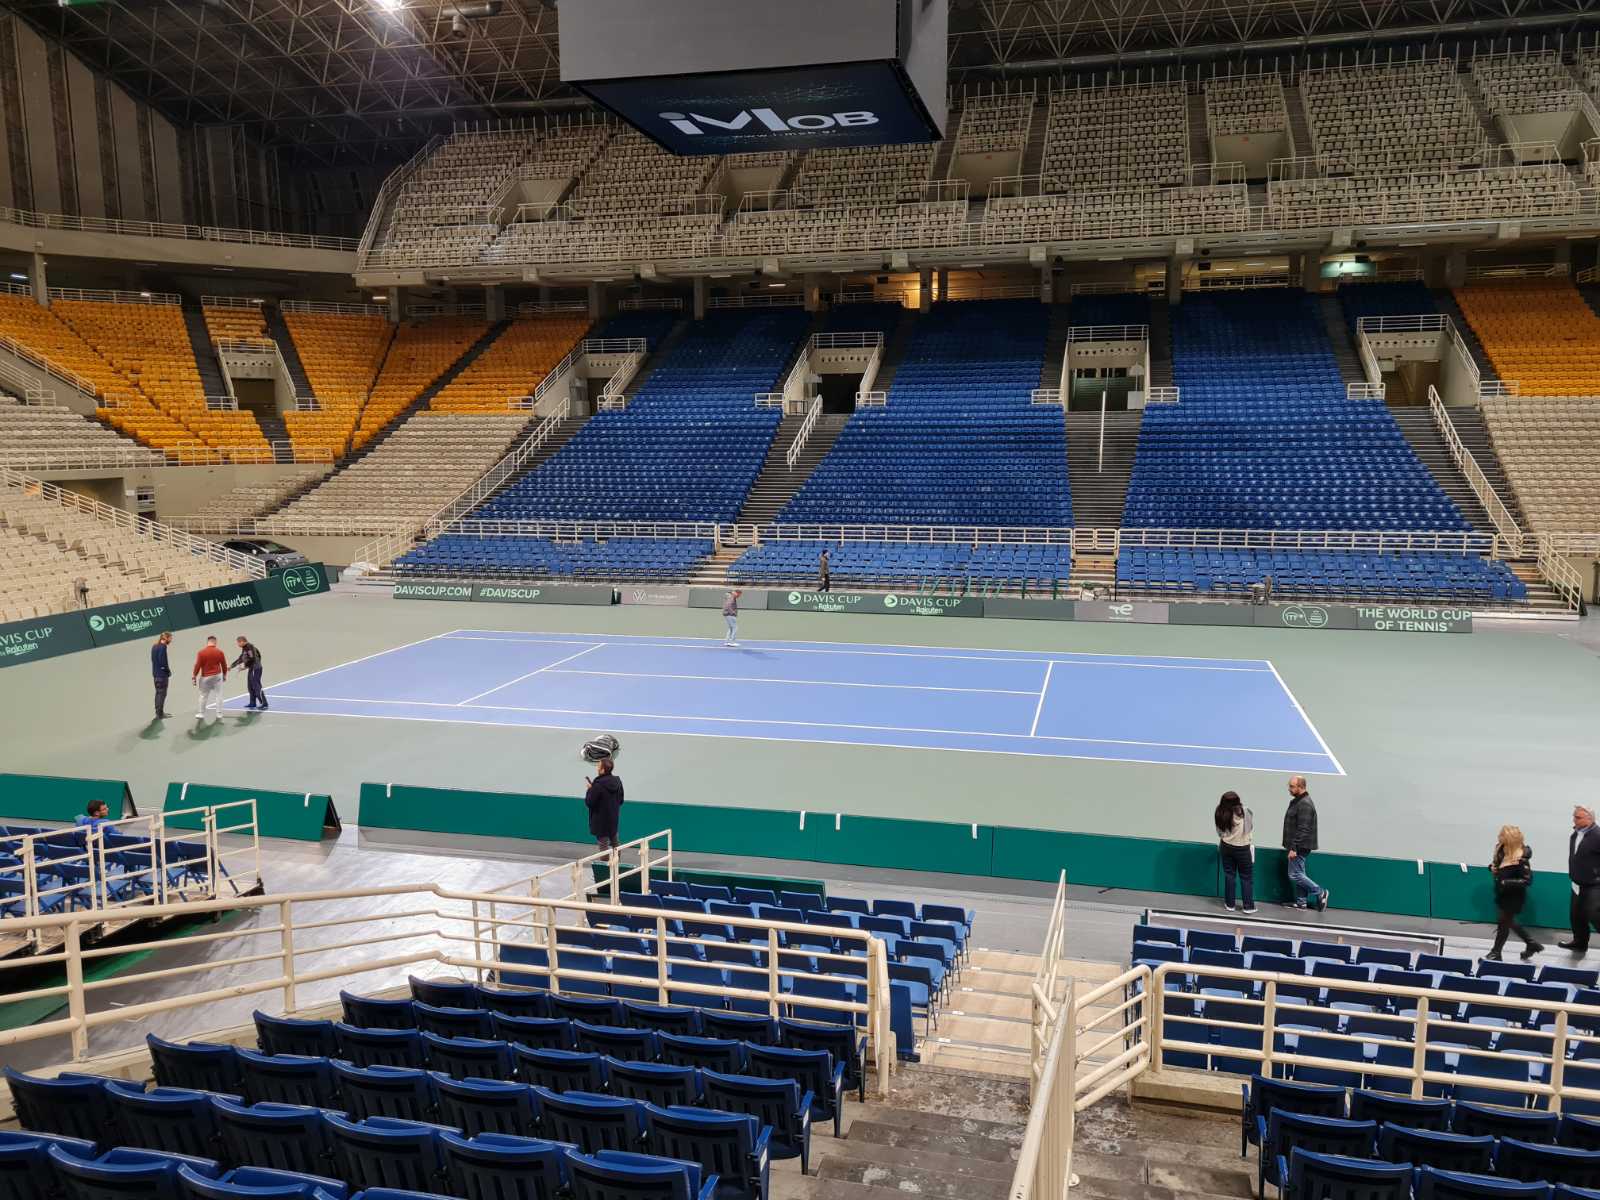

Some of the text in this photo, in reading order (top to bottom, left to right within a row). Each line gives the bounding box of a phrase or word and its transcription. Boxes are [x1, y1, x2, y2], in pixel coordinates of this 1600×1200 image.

[393, 585, 472, 597] DAVISCUP.COM
[479, 587, 540, 599] #DAVISCUP
[215, 594, 253, 611] howden
[803, 594, 861, 605] DAVIS CUP
[900, 597, 960, 608] DAVIS CUP
[818, 603, 845, 611] Rakuten
[915, 606, 943, 615] Rakuten
[106, 607, 165, 626] DAVIS CUP
[1357, 608, 1472, 621] THE WORLD CUP
[126, 620, 153, 632] Rakuten
[1374, 620, 1449, 632] OF TENNIS
[25, 627, 53, 641] CUP
[5, 642, 39, 656] Rakuten
